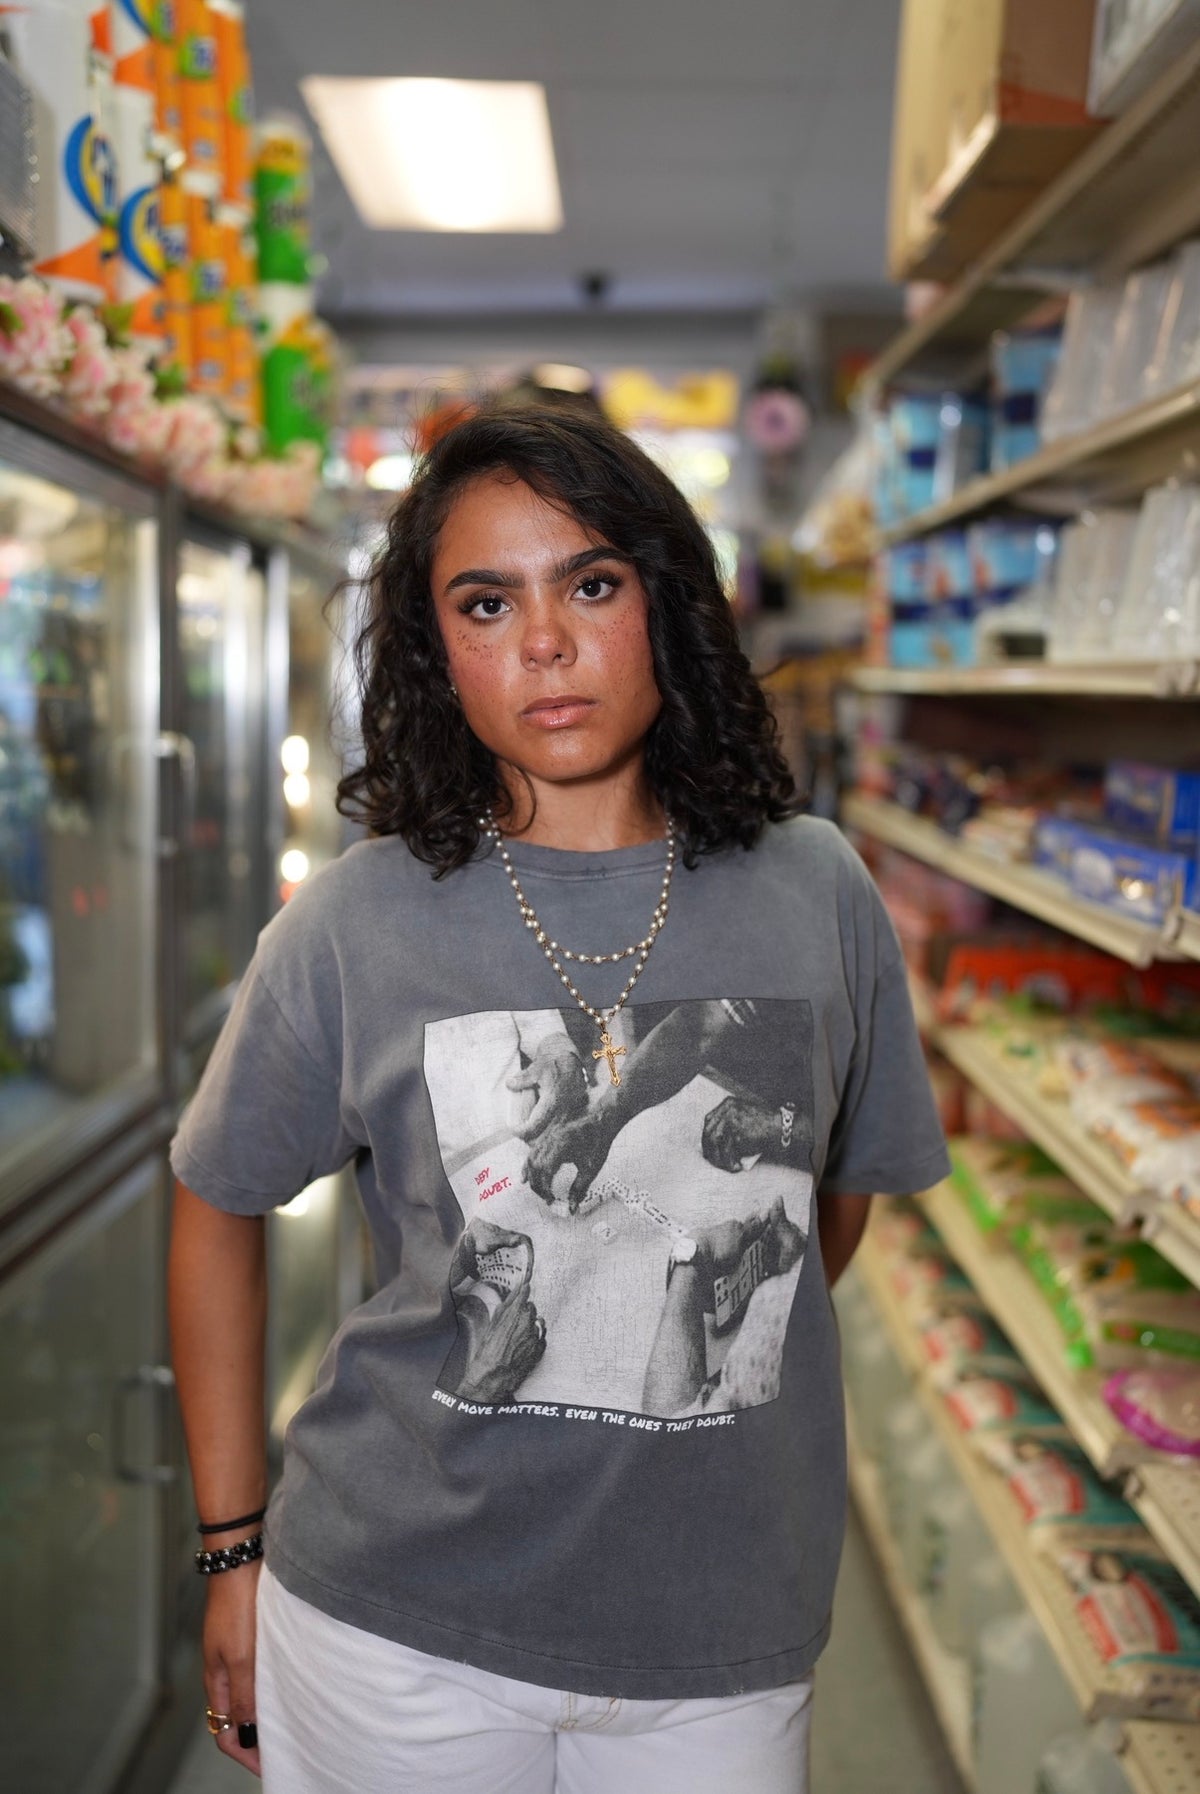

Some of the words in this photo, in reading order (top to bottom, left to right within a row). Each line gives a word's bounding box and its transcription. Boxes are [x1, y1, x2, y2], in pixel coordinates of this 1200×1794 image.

[431, 1390, 457, 1409] EVERY
[458, 1401, 493, 1415] MOVE
[498, 1404, 560, 1417] MATTERS.
[565, 1408, 598, 1421] EVEN
[602, 1412, 626, 1425] THE
[629, 1416, 662, 1432] ONES
[666, 1418, 695, 1433] THEY
[696, 1414, 736, 1428] DOUBT.
